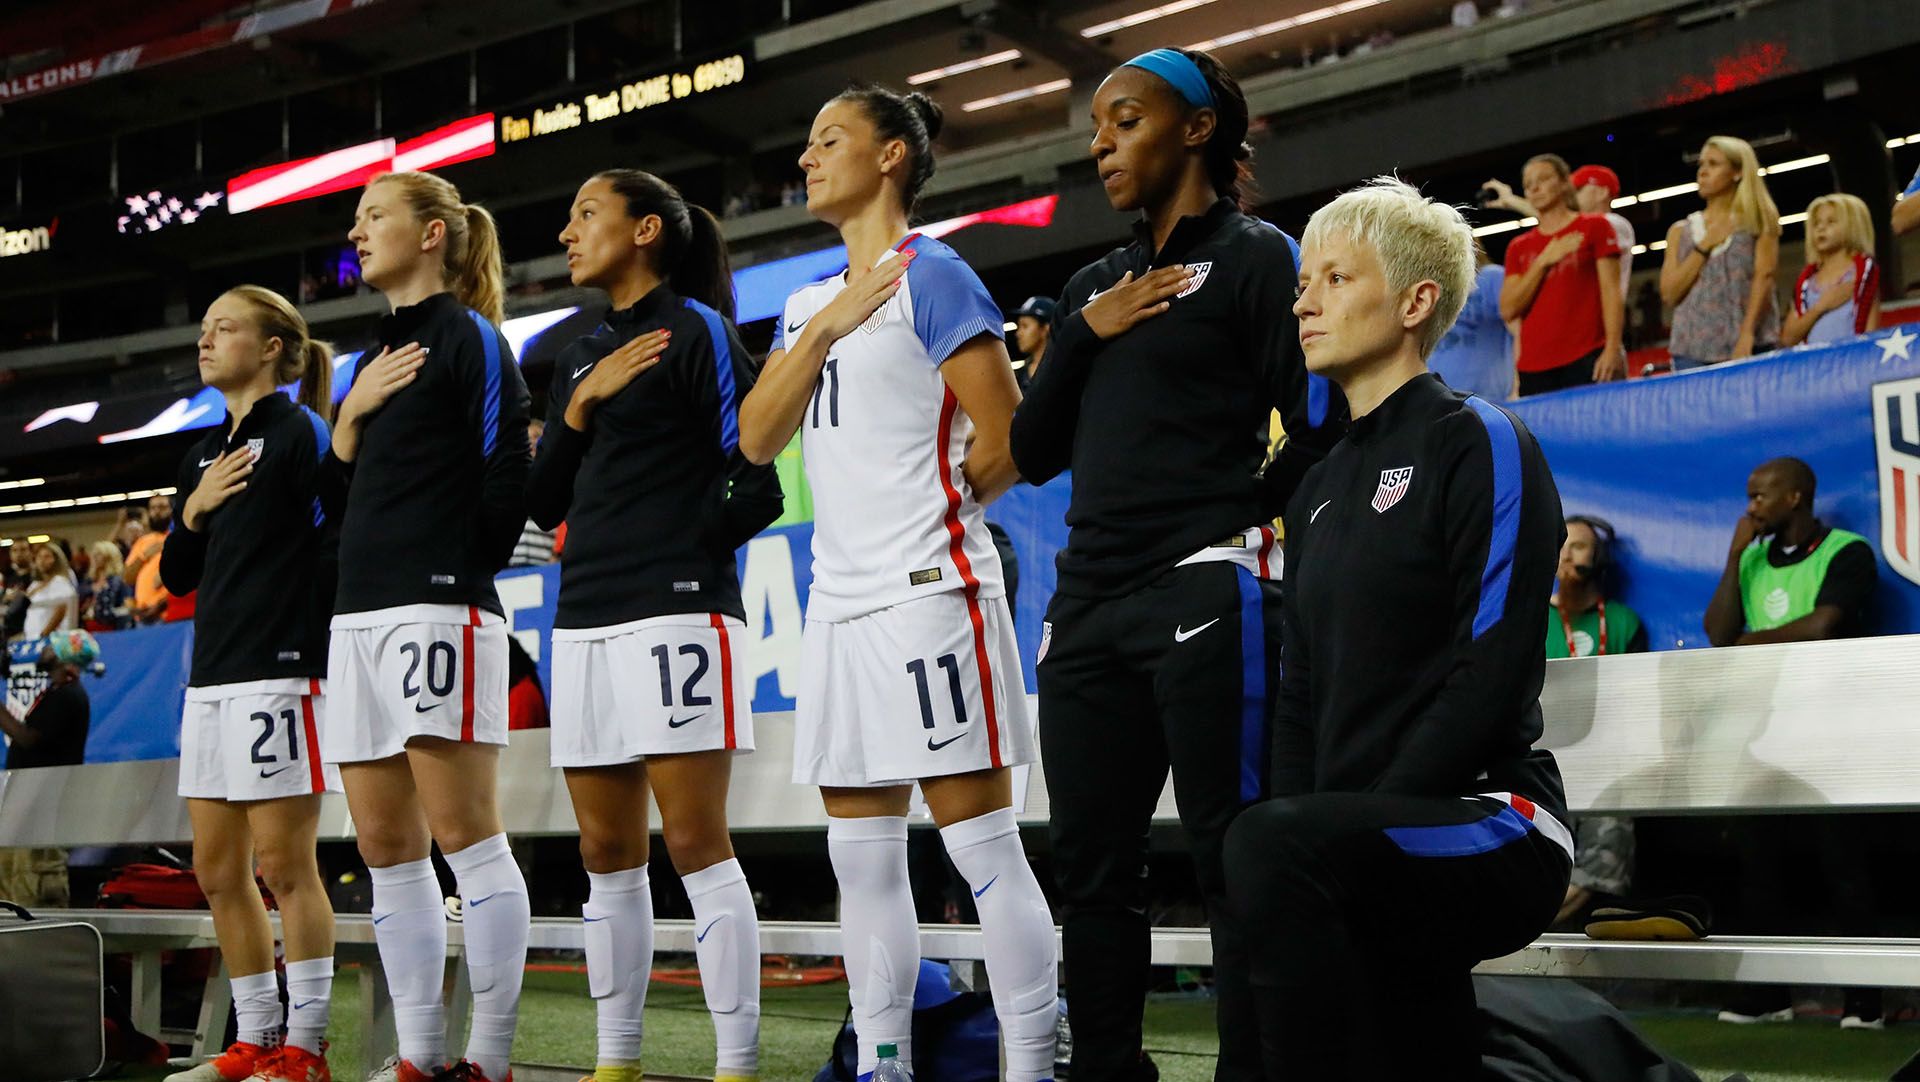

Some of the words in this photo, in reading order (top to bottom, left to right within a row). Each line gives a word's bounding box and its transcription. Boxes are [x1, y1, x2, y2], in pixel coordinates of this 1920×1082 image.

[501, 116, 530, 143] Fan
[532, 102, 581, 136] Assist:
[584, 90, 620, 122] Text
[621, 74, 671, 113] DOME
[671, 72, 692, 99] to
[1381, 468, 1411, 487] USA
[400, 640, 457, 699] 20
[651, 643, 713, 707] 12
[906, 653, 968, 729] 11
[250, 708, 298, 764] 21
